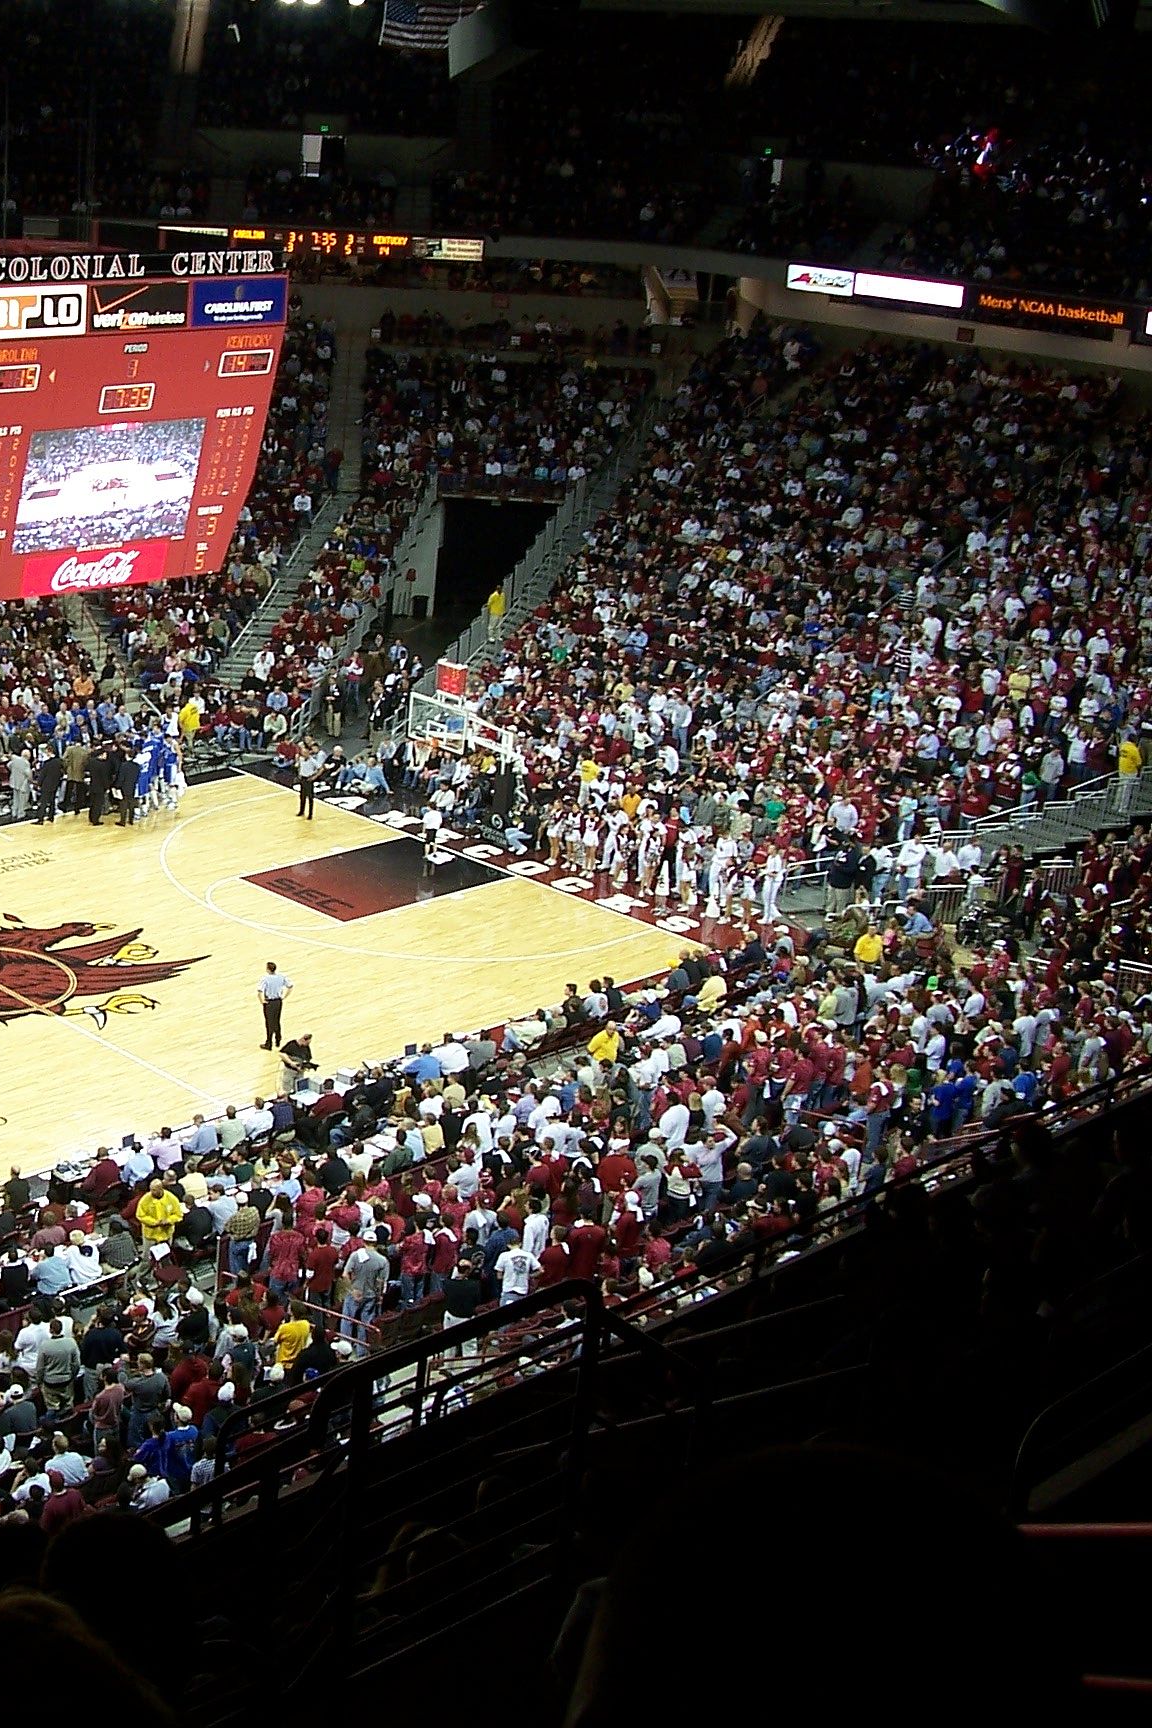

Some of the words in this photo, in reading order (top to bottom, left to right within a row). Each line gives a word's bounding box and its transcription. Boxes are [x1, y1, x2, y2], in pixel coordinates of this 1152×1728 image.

[172, 250, 274, 276] CENTER
[93, 309, 149, 329] verizon
[148, 311, 185, 326] wireless
[979, 294, 1018, 310] Mens'
[1018, 299, 1055, 316] NCAA
[1057, 303, 1124, 325] basketball
[226, 334, 271, 348] KENTUCKY
[229, 355, 247, 371] 14
[17, 368, 35, 387] 15
[117, 388, 150, 407] 7:35
[206, 517, 217, 536] 3
[194, 552, 205, 570] 5
[266, 877, 355, 912] SEC
